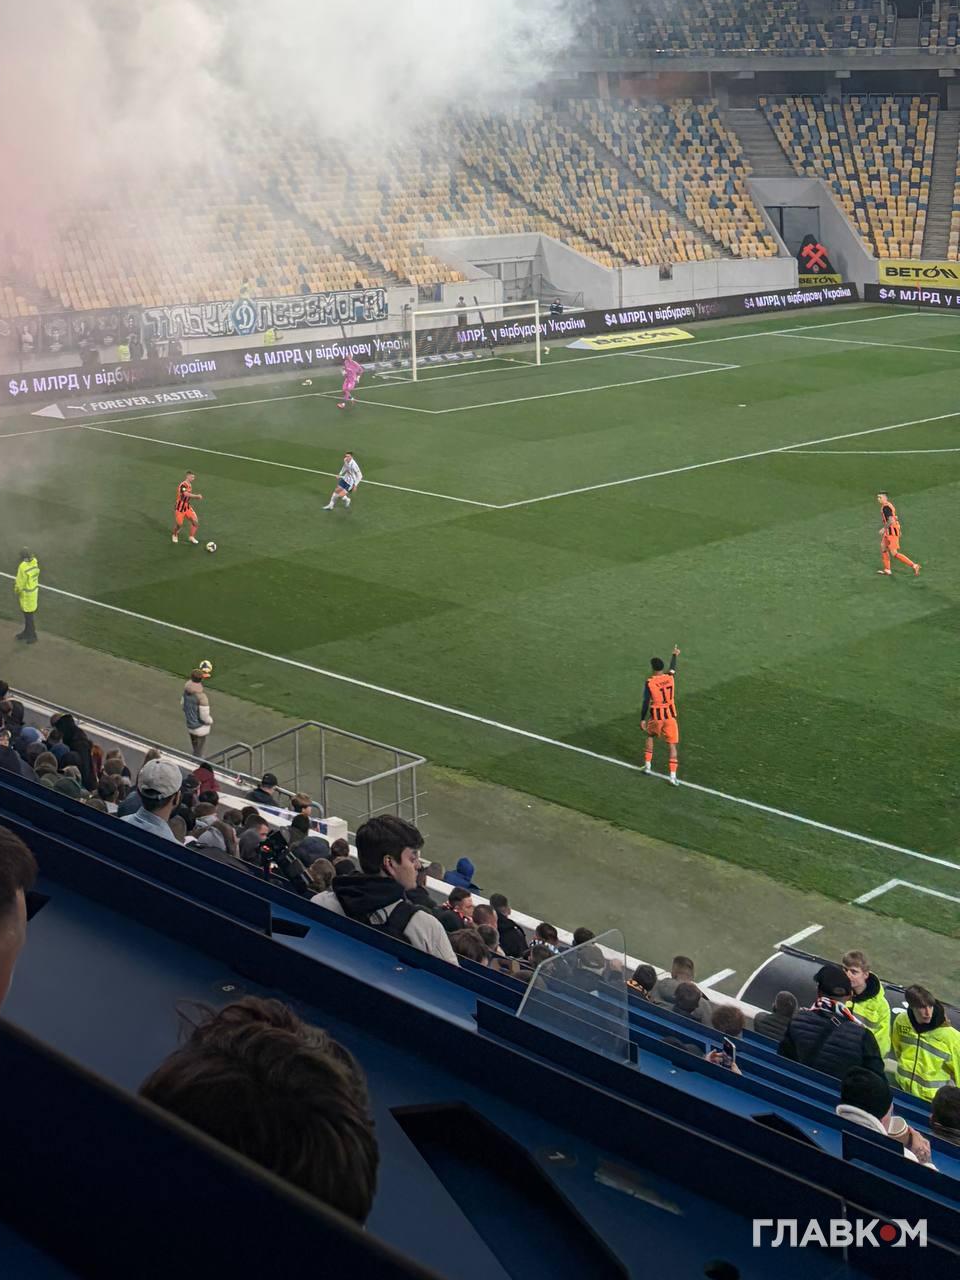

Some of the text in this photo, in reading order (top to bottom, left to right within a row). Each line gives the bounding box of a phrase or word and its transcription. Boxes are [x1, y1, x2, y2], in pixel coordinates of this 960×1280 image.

[756, 294, 781, 307] МЛРД
[823, 287, 851, 300] України
[879, 288, 897, 300] $4
[900, 290, 941, 305] МЛРД
[548, 317, 586, 332] України
[605, 313, 618, 327] $4
[619, 310, 648, 325] МЛРД
[655, 305, 696, 321] відбудову
[244, 353, 262, 369] $4
[265, 348, 303, 365] МЛРД
[306, 350, 313, 363] у
[8, 378, 29, 396] $4
[33, 372, 78, 393] МЛРД
[82, 373, 91, 390] у
[90, 388, 208, 412] FOREVER. FASTER.
[659, 686, 673, 704] 17
